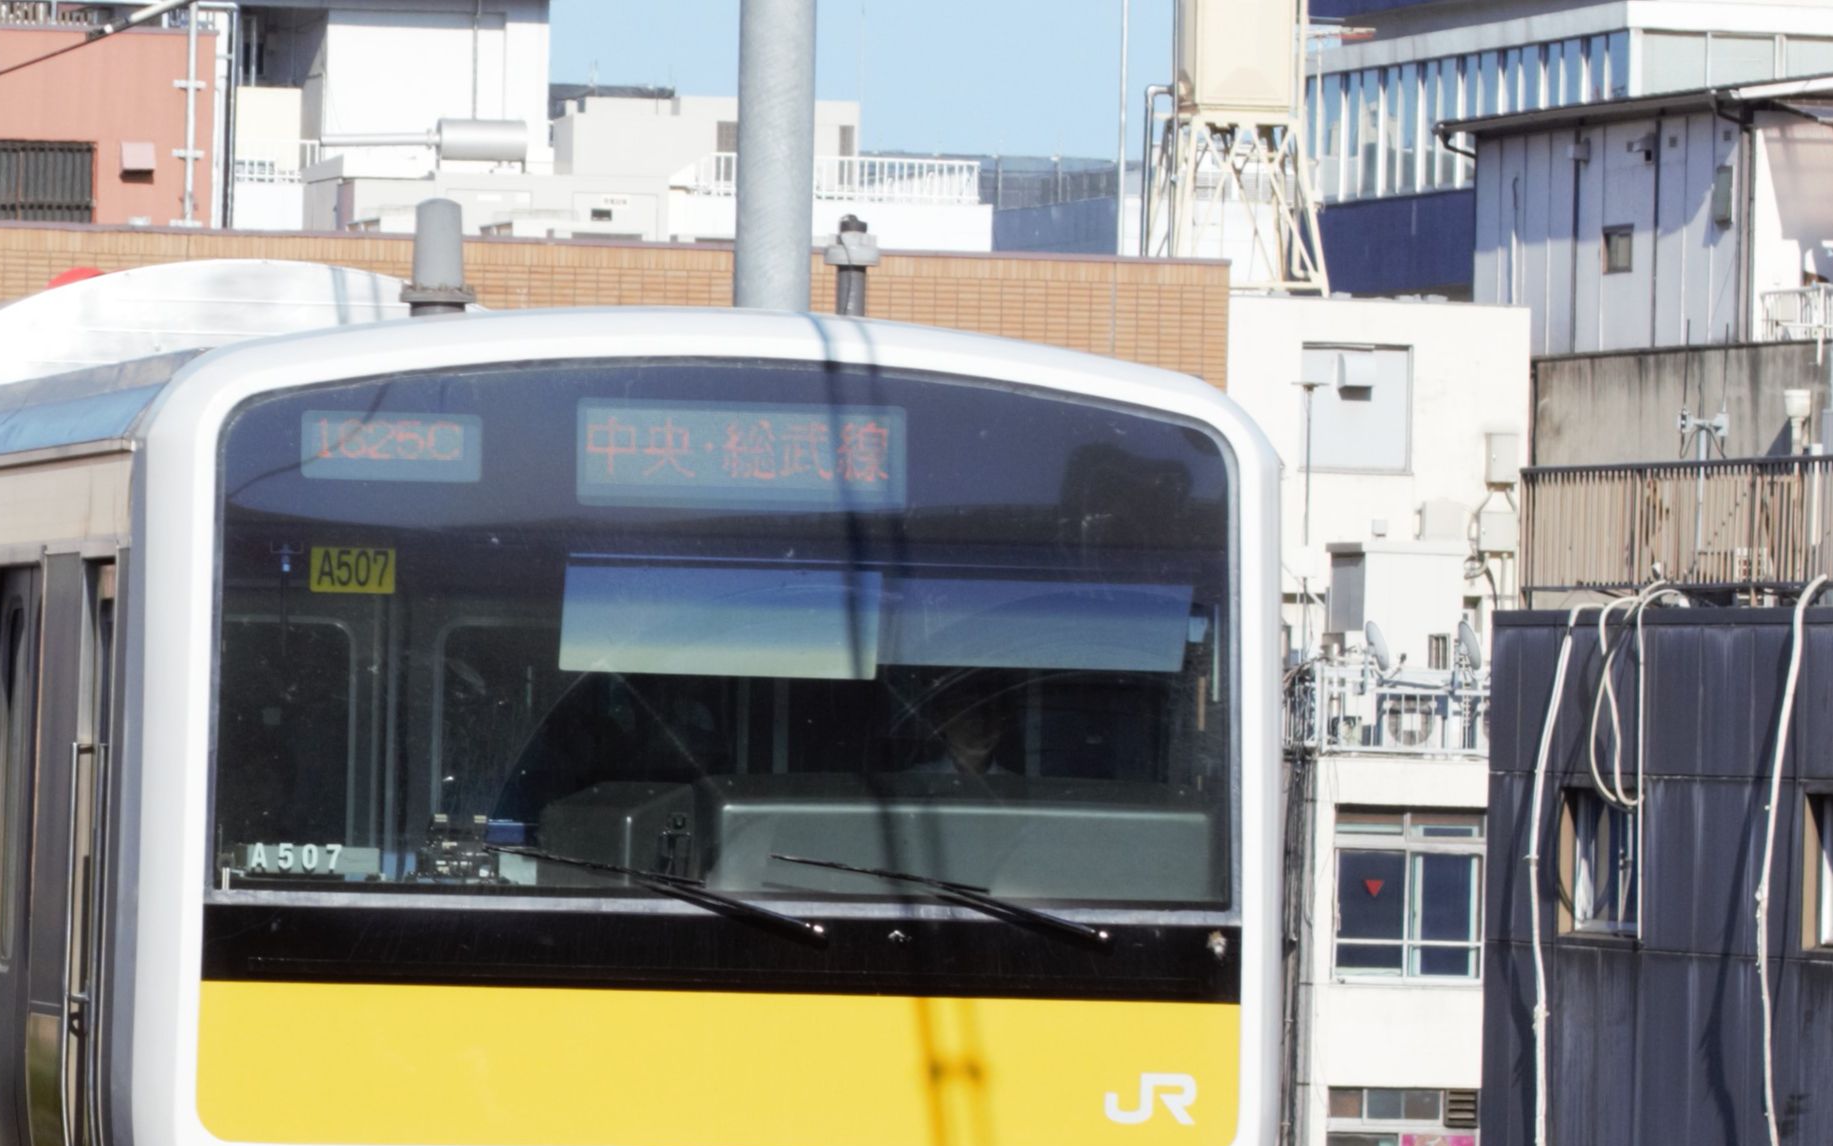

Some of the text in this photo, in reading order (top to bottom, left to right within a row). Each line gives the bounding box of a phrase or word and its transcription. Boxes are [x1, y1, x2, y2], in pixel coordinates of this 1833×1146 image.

[319, 418, 462, 461] 1625C
[587, 415, 888, 482] 中央・総武線
[317, 549, 389, 588] A507
[250, 842, 343, 871] A507
[1104, 1072, 1197, 1125] JR
